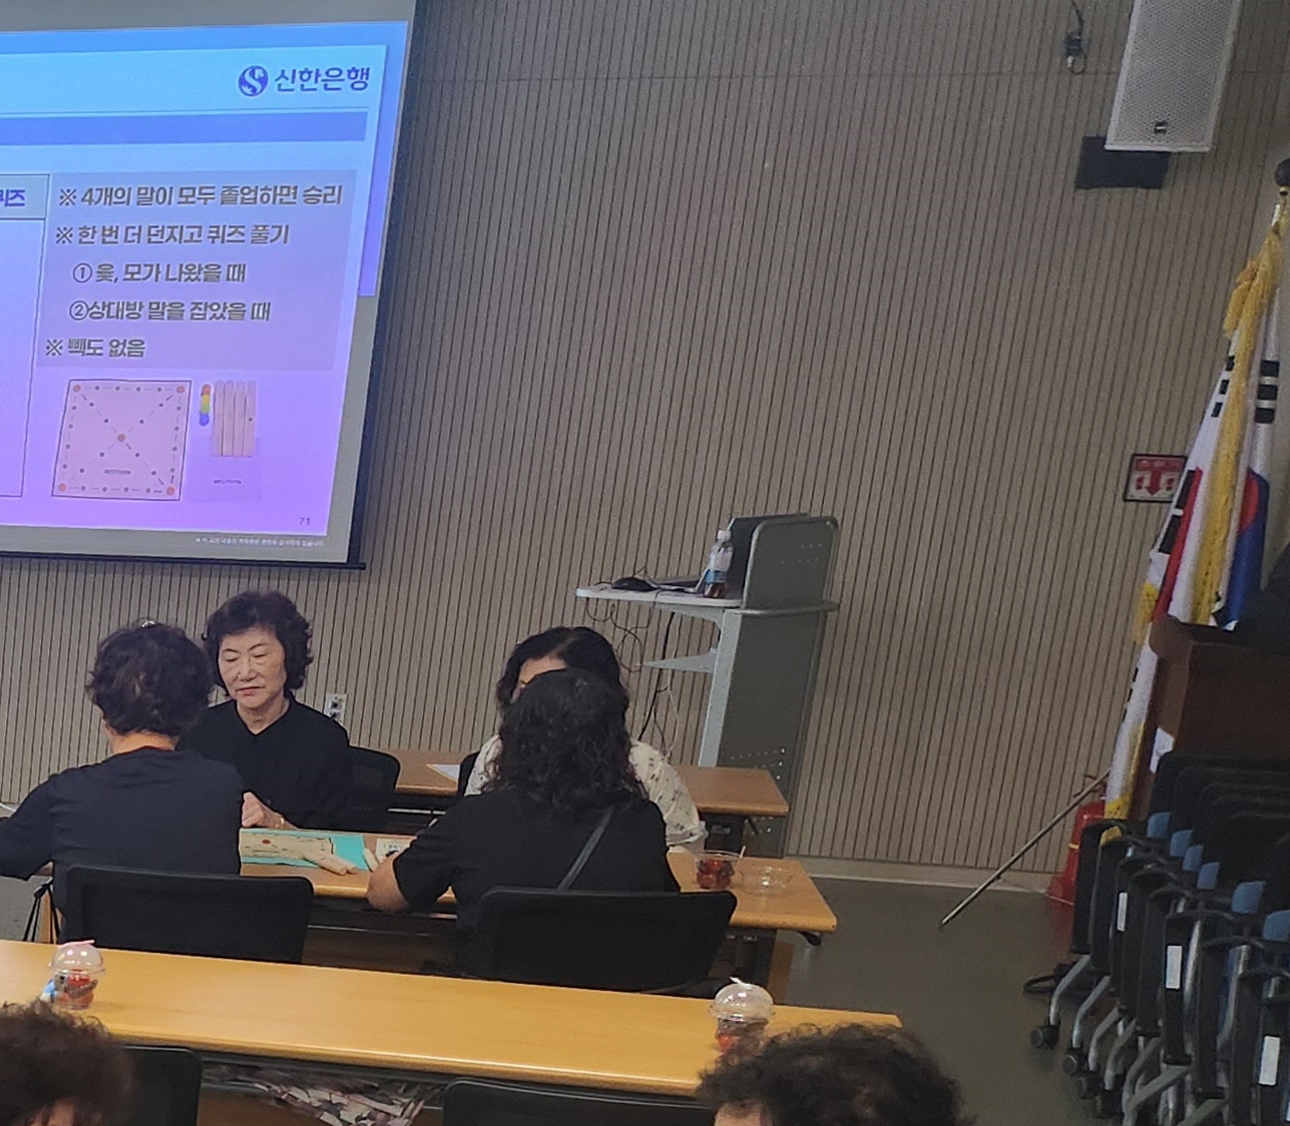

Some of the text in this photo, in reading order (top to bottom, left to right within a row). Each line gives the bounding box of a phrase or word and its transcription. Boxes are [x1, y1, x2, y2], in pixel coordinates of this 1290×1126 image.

[274, 66, 370, 92] 신한은행
[80, 187, 131, 206] 4개의
[135, 186, 173, 206] 말이
[177, 186, 216, 206] 모두
[219, 185, 297, 205] 졸업하면
[302, 184, 343, 205] 승리
[77, 225, 96, 244] 한
[100, 225, 119, 244] 번
[123, 225, 141, 244] 더
[146, 225, 204, 244] 던지고
[207, 225, 246, 244] 퀴즈
[250, 224, 290, 244] 풀기
[123, 263, 161, 282] 모가
[165, 263, 222, 282] 나왔을
[225, 263, 247, 282] 때
[148, 302, 185, 321] 말을
[190, 302, 247, 321] 잡았을
[251, 301, 271, 321] 때
[108, 338, 146, 358] 없음
[299, 517, 311, 526] 71
